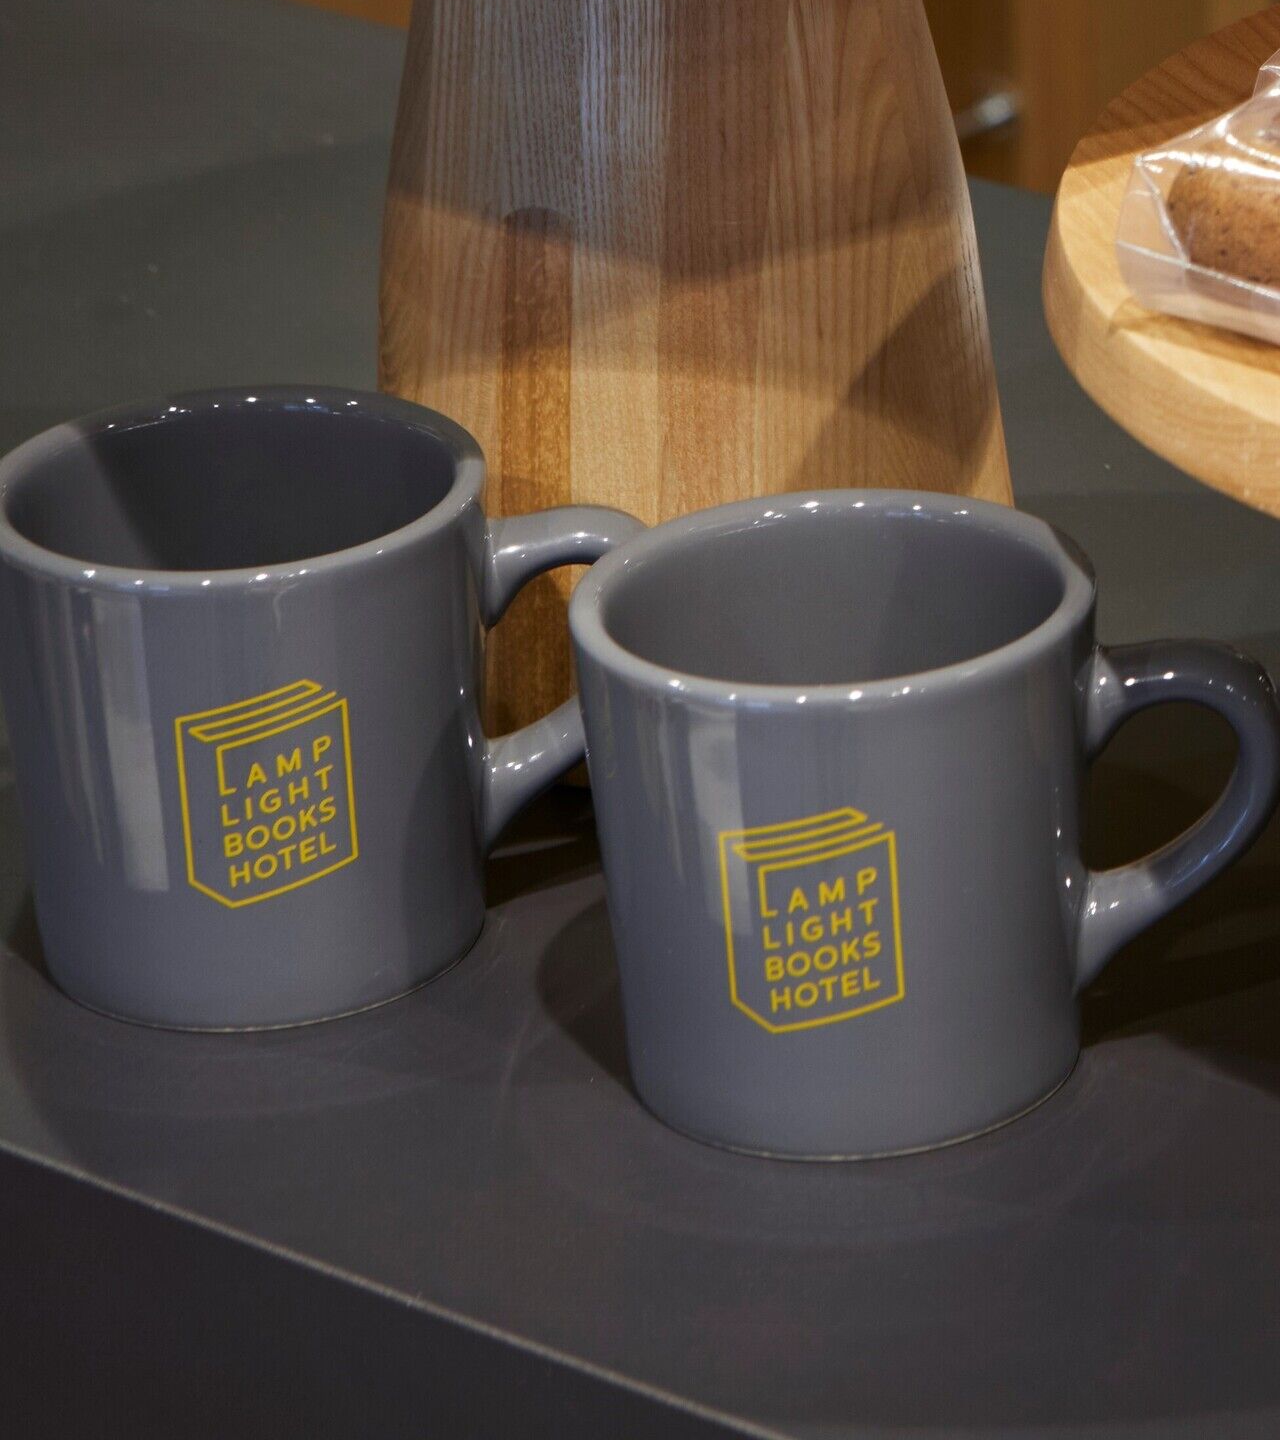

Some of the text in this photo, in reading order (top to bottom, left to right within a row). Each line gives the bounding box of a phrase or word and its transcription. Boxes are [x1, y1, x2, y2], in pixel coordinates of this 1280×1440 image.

[216, 735, 332, 796] LAMP
[221, 764, 334, 827] LIGHT
[223, 796, 336, 858] BOOKS
[229, 831, 337, 889] HOTEL
[758, 866, 878, 918] LAMP
[763, 897, 879, 950] LIGHT
[765, 930, 882, 982] BOOKS
[770, 965, 881, 1014] HOTEL
